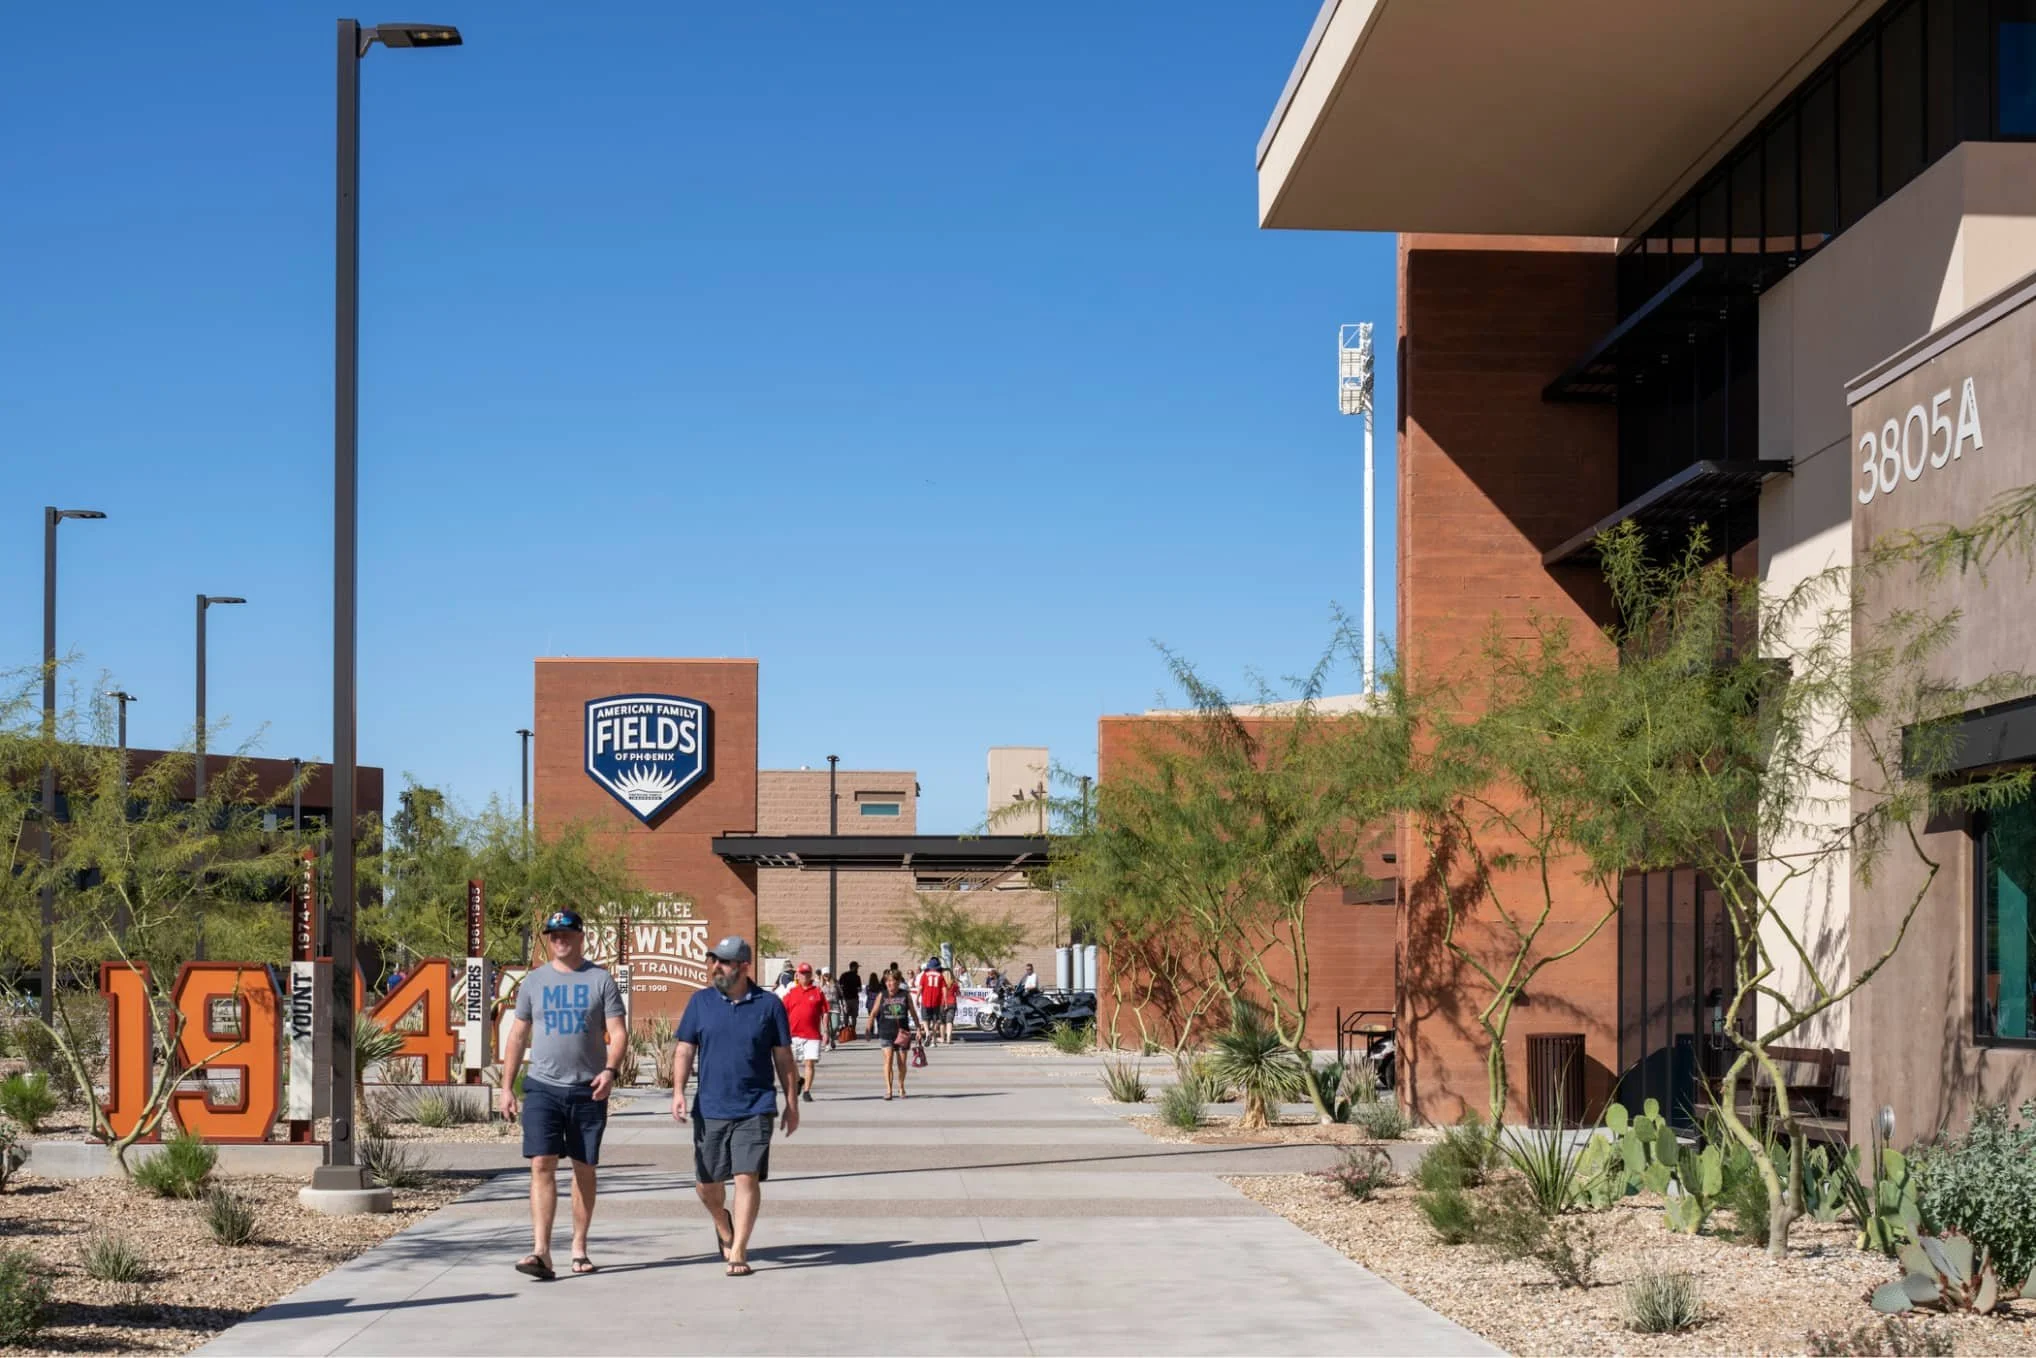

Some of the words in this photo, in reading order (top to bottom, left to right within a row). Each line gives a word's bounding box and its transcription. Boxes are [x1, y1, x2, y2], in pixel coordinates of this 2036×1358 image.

[1858, 376, 1983, 505] 3805A
[597, 704, 654, 719] AMERICAN
[657, 705, 696, 719] FAMILY
[597, 716, 696, 754] FIELDS
[615, 753, 628, 761] OF
[630, 753, 675, 761] PHOENIX
[640, 962, 708, 983] TRAINING
[927, 974, 939, 987] 11
[293, 972, 312, 1041] YOUNT
[468, 964, 482, 1022] FINGERS
[542, 983, 590, 1009] MLB
[543, 1008, 589, 1036] PDX
[100, 960, 279, 1144] 19
